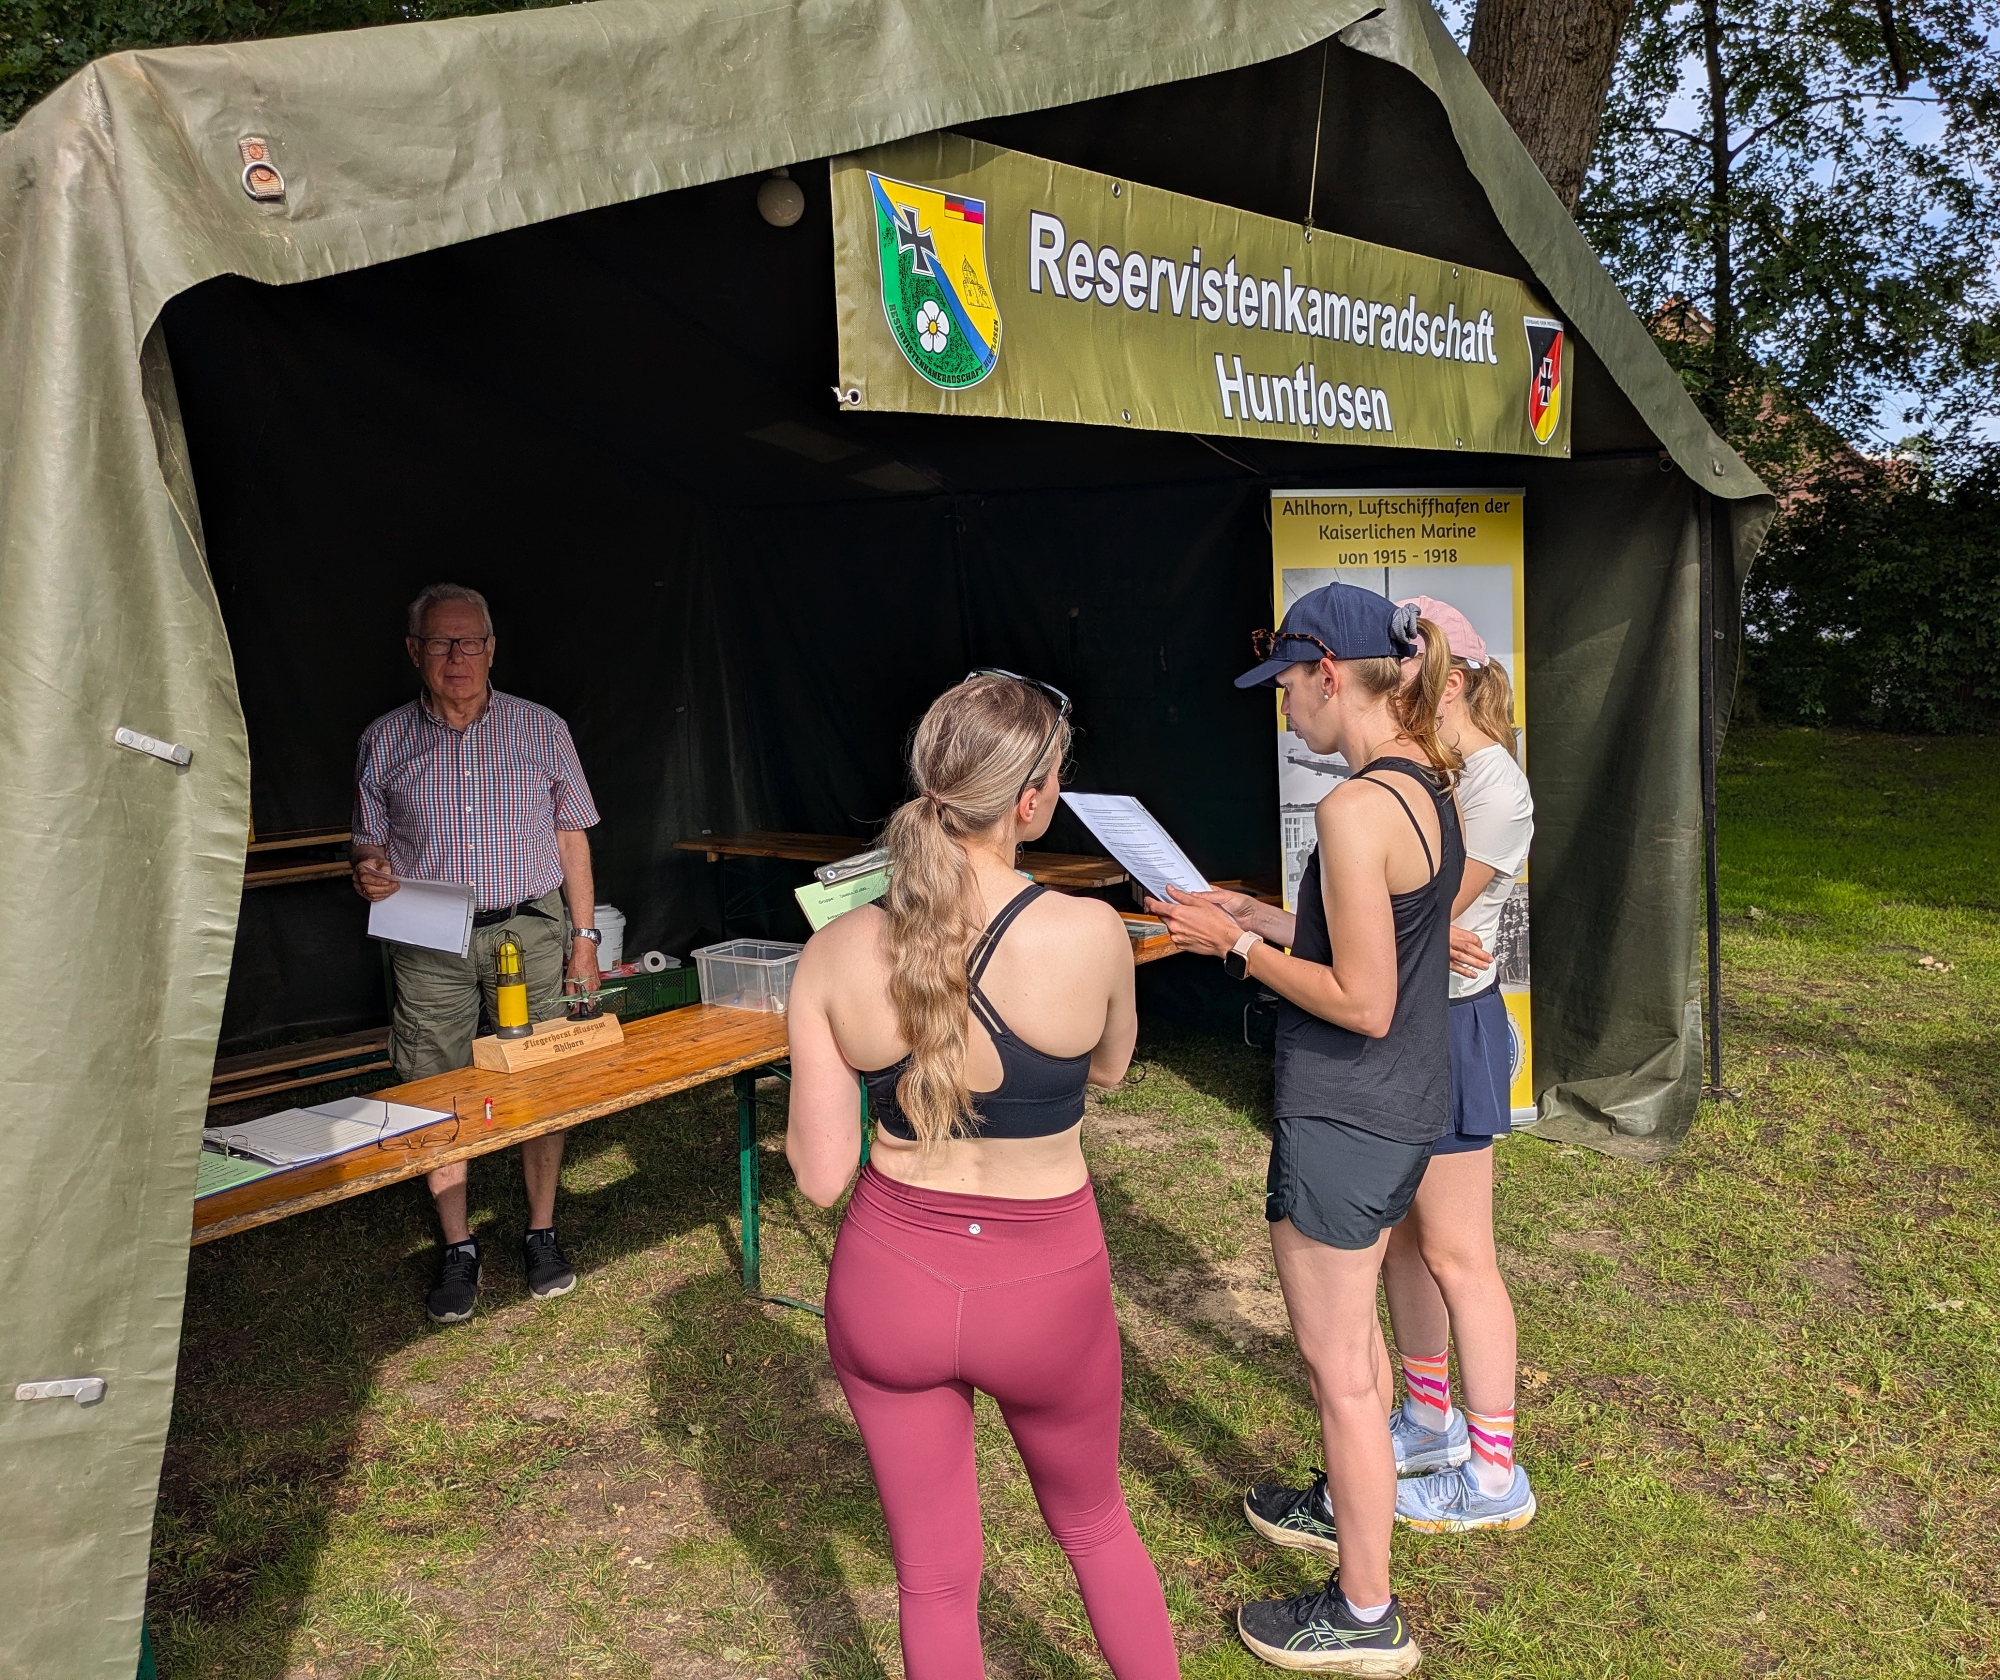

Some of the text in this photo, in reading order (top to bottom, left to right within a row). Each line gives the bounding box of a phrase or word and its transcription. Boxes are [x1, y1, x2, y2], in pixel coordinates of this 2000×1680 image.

[1029, 209, 1499, 366] Reservistenkameradschaft
[889, 303, 999, 384] RESERVISTENKAMERADSCHAFT HUNTLOSEN
[1214, 352, 1393, 432] Huntlosen
[1282, 498, 1511, 518] Ahlhorn, Luftschiffhafen der
[1319, 523, 1477, 540] Kaiserlichen Marine
[1338, 552, 1369, 565] von
[1373, 549, 1407, 564] 1915
[1423, 549, 1458, 564] 1918
[522, 1021, 606, 1050] Fliegerhorst Museum
[552, 1039, 585, 1053] Ahlhorn
